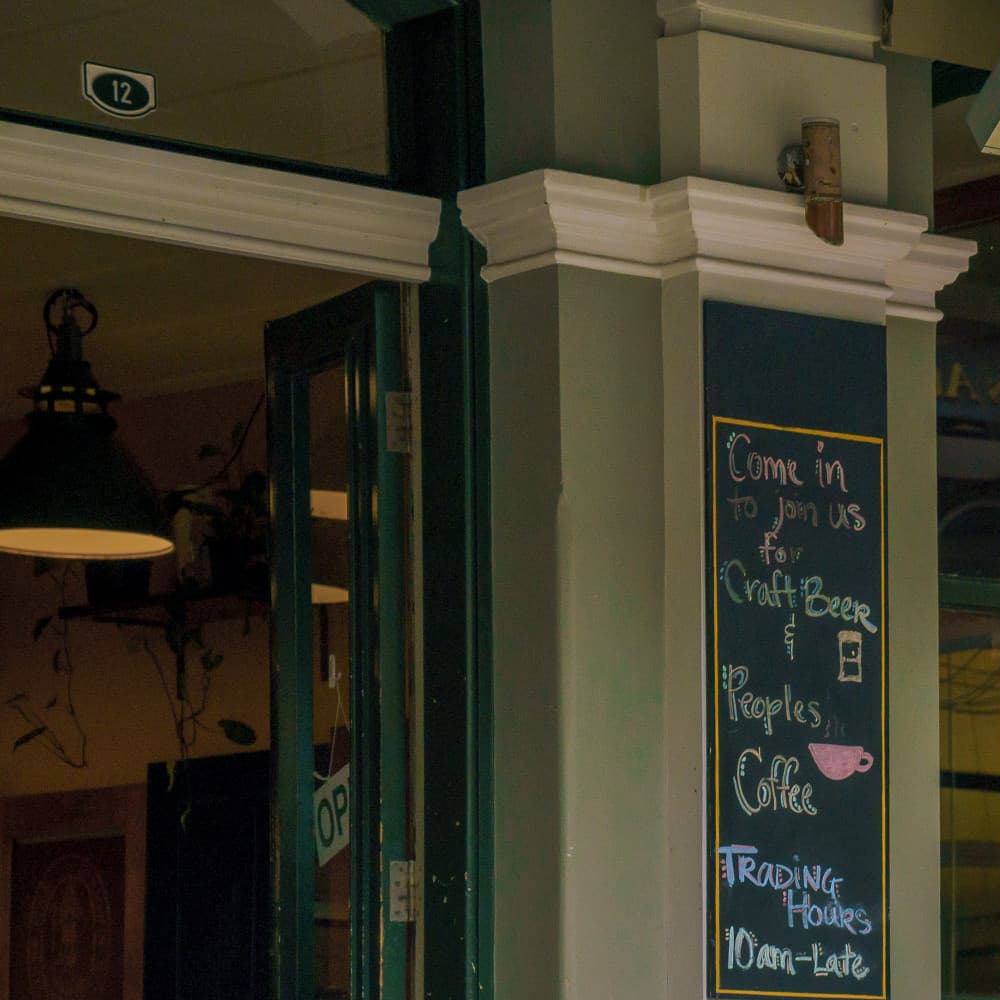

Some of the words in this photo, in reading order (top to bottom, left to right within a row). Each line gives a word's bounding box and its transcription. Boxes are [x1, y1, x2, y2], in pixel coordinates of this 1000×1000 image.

[112, 80, 132, 104] 12
[728, 433, 804, 486] Come
[816, 440, 848, 493] in
[829, 501, 866, 531] us
[758, 531, 803, 564] for
[724, 559, 797, 608] Craft
[728, 664, 822, 735] Peoples
[733, 747, 817, 815] Coffee
